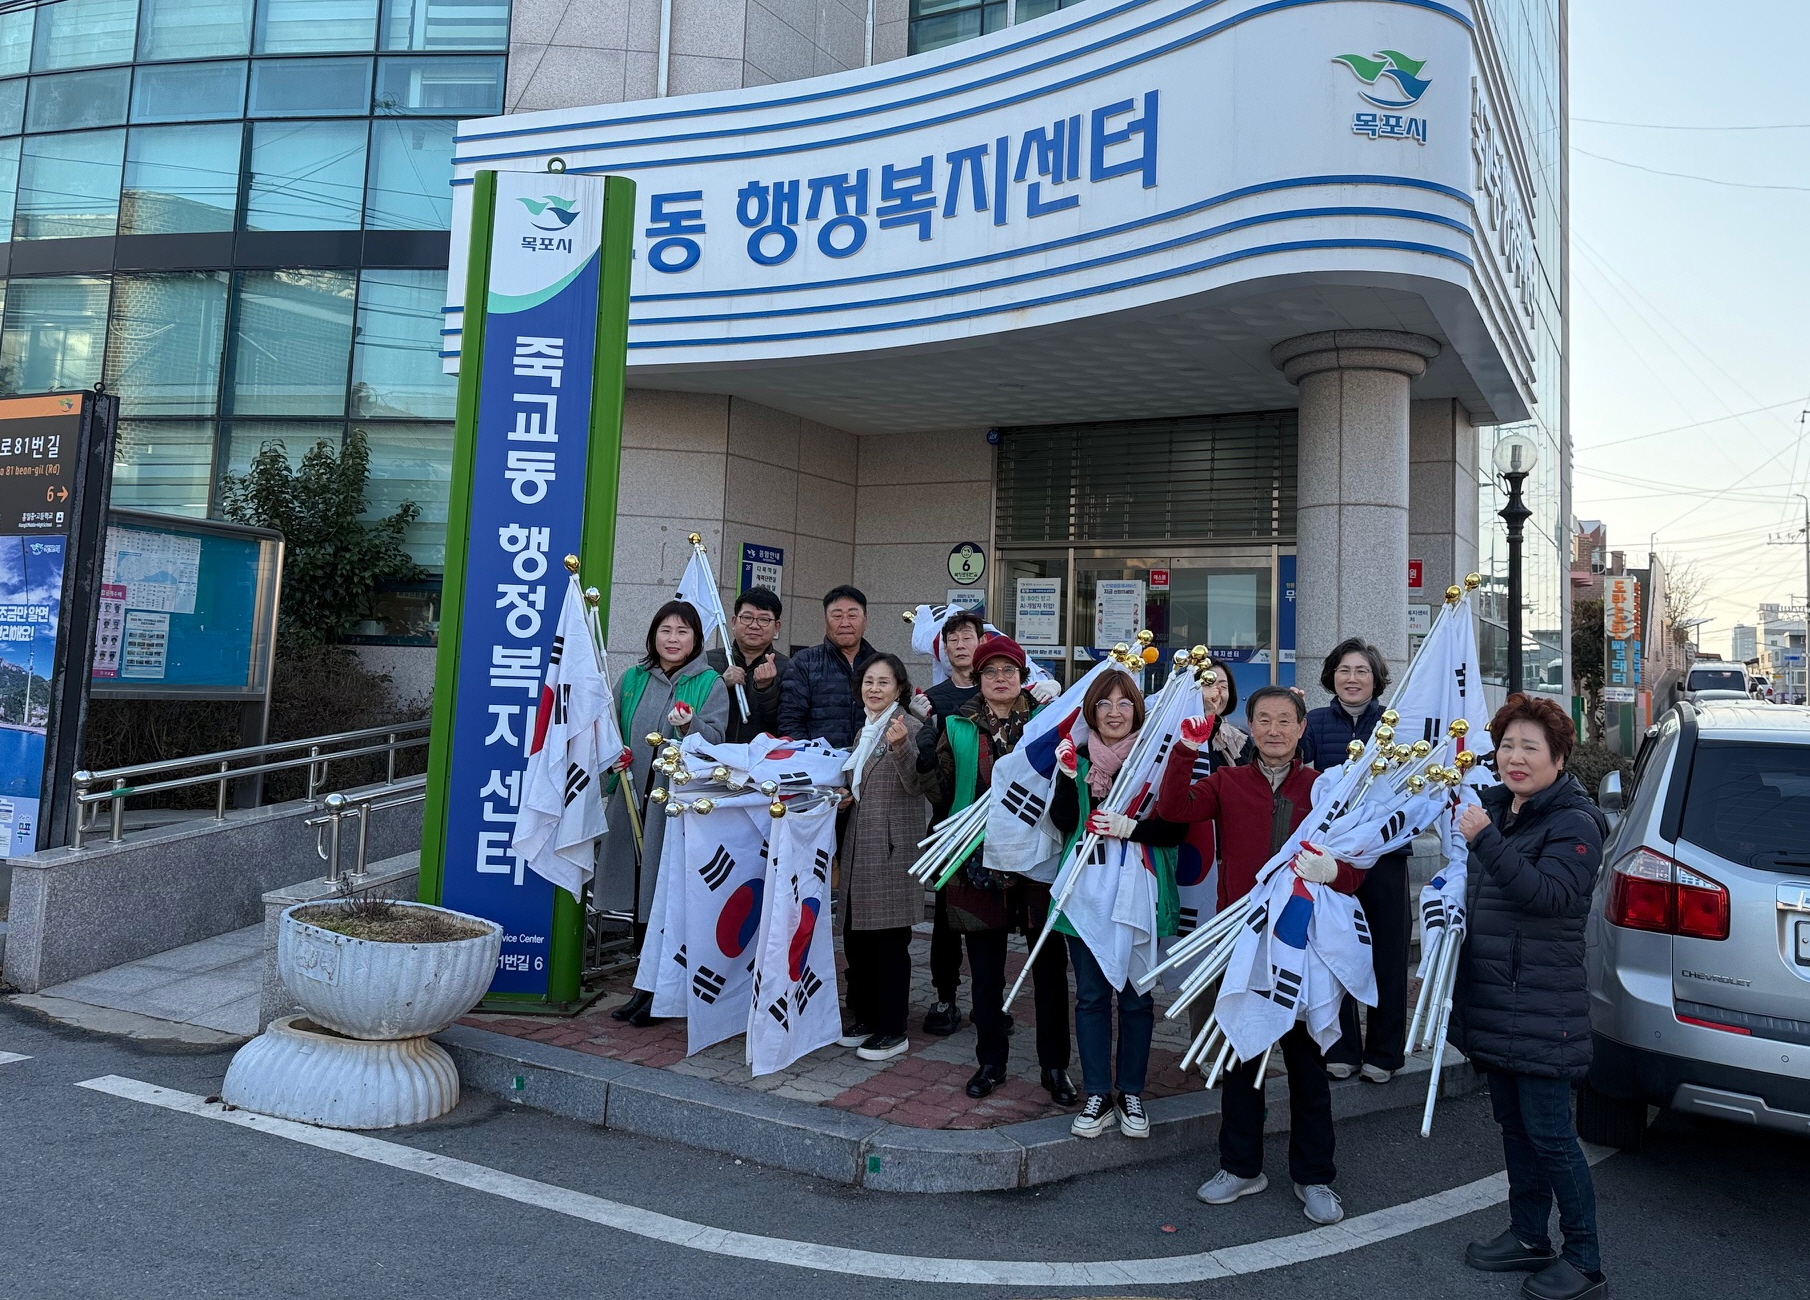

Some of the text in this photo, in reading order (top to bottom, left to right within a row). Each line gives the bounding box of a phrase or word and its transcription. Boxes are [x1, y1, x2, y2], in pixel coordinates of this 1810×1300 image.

[1351, 111, 1428, 146] 목포시
[645, 88, 1160, 273] 동 행정복지센터
[521, 236, 573, 255] 목포시
[504, 336, 565, 506] 죽교동
[15, 464, 44, 477] beon-gil
[45, 463, 60, 476] (Rd)
[46, 485, 55, 502] 6
[962, 560, 970, 571] 6
[0, 605, 49, 622] 조금만 알면
[1612, 580, 1626, 640] 도란도란
[0, 625, 34, 641] 리해요!
[1612, 640, 1627, 685] 빨래터
[502, 934, 544, 944] vice Center
[497, 954, 544, 971] 1번길 6
[1682, 969, 1753, 987] CHEVROLET
